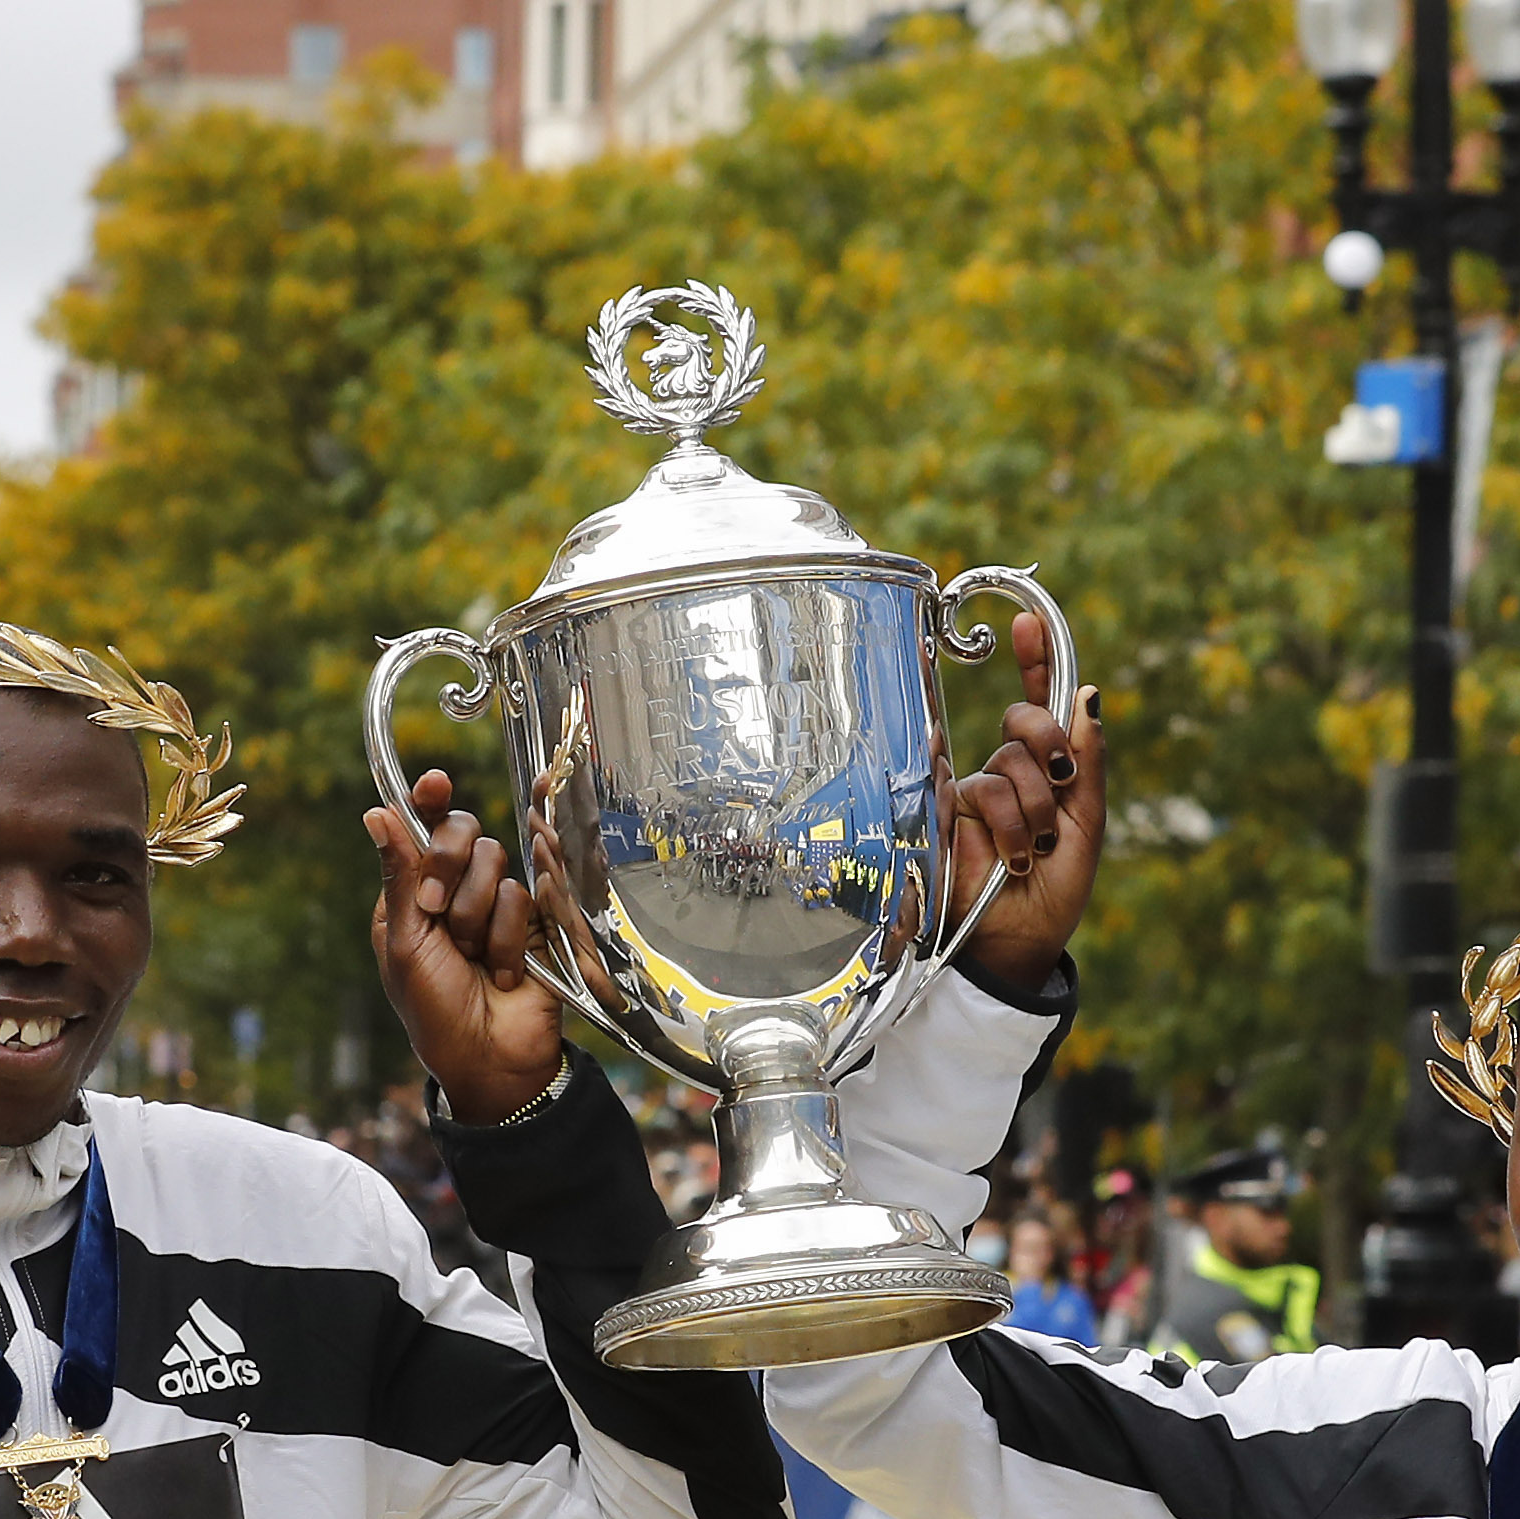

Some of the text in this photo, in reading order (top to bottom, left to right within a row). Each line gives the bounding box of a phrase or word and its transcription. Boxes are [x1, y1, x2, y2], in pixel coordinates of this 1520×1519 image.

[646, 677, 836, 740] BOSTON
[614, 729, 880, 793] MARATHON
[158, 1355, 261, 1398] adidas
[40, 1443, 94, 1460] MARATHON
